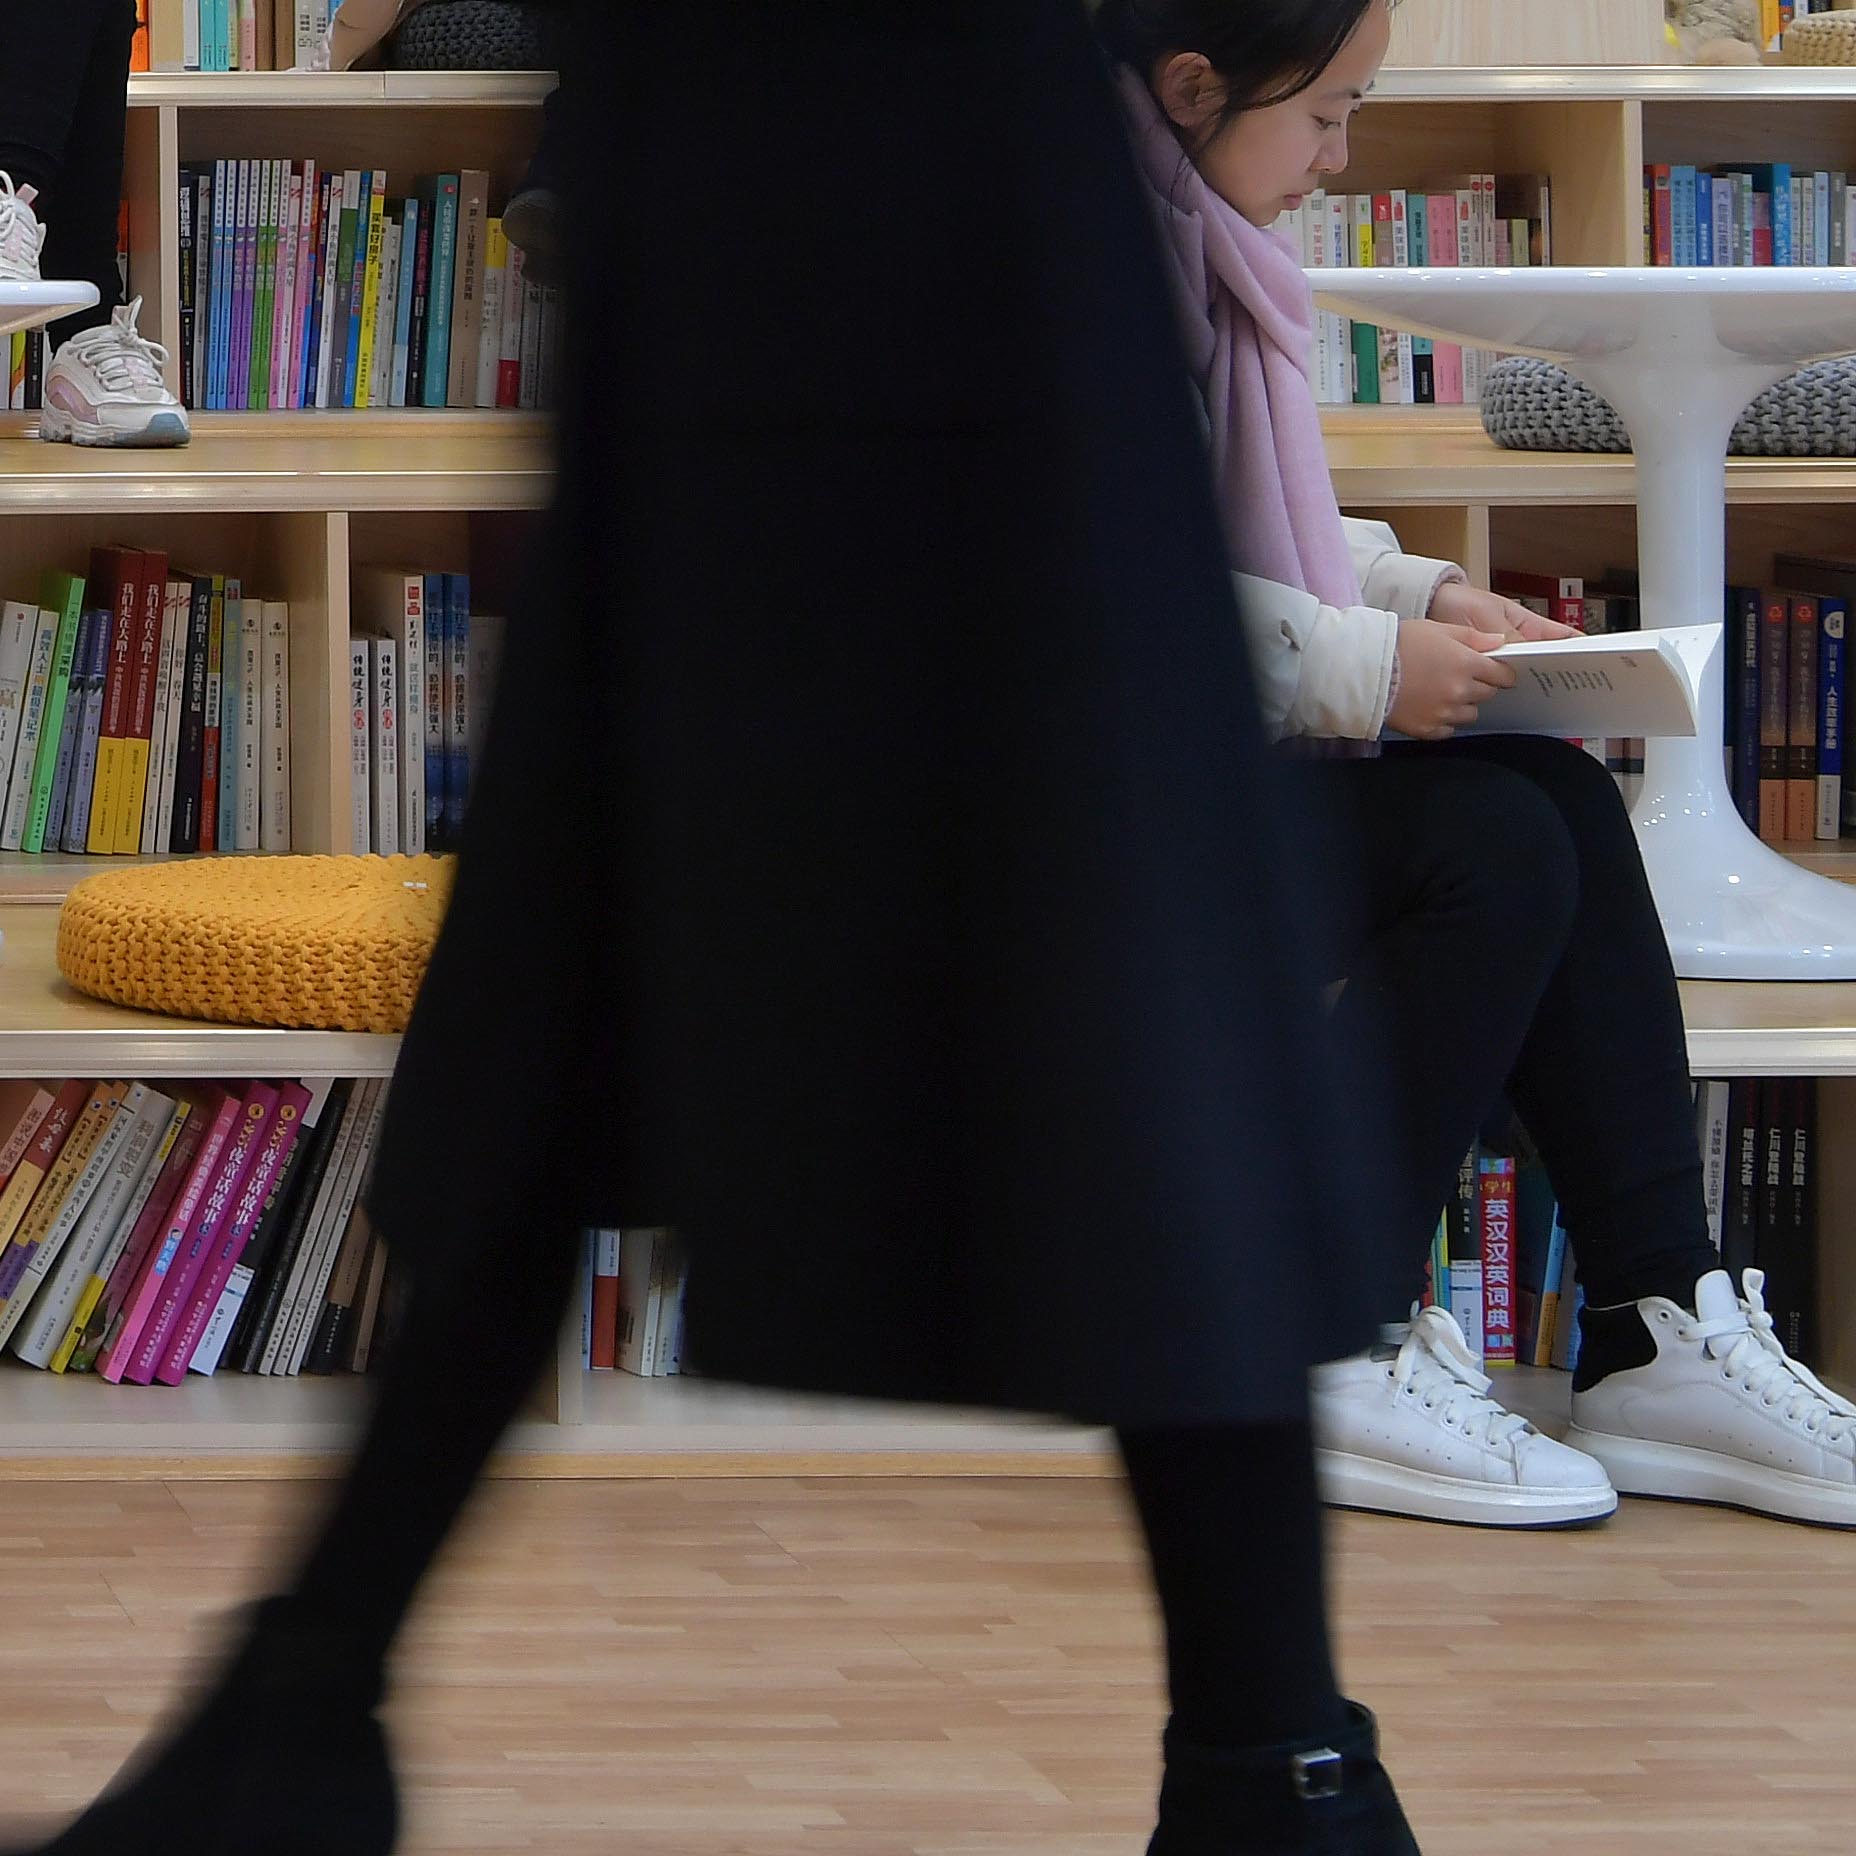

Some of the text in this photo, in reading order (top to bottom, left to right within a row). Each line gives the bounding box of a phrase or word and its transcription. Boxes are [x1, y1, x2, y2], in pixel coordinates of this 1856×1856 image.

[1483, 1199, 1512, 1330] 英汉汉英词典
